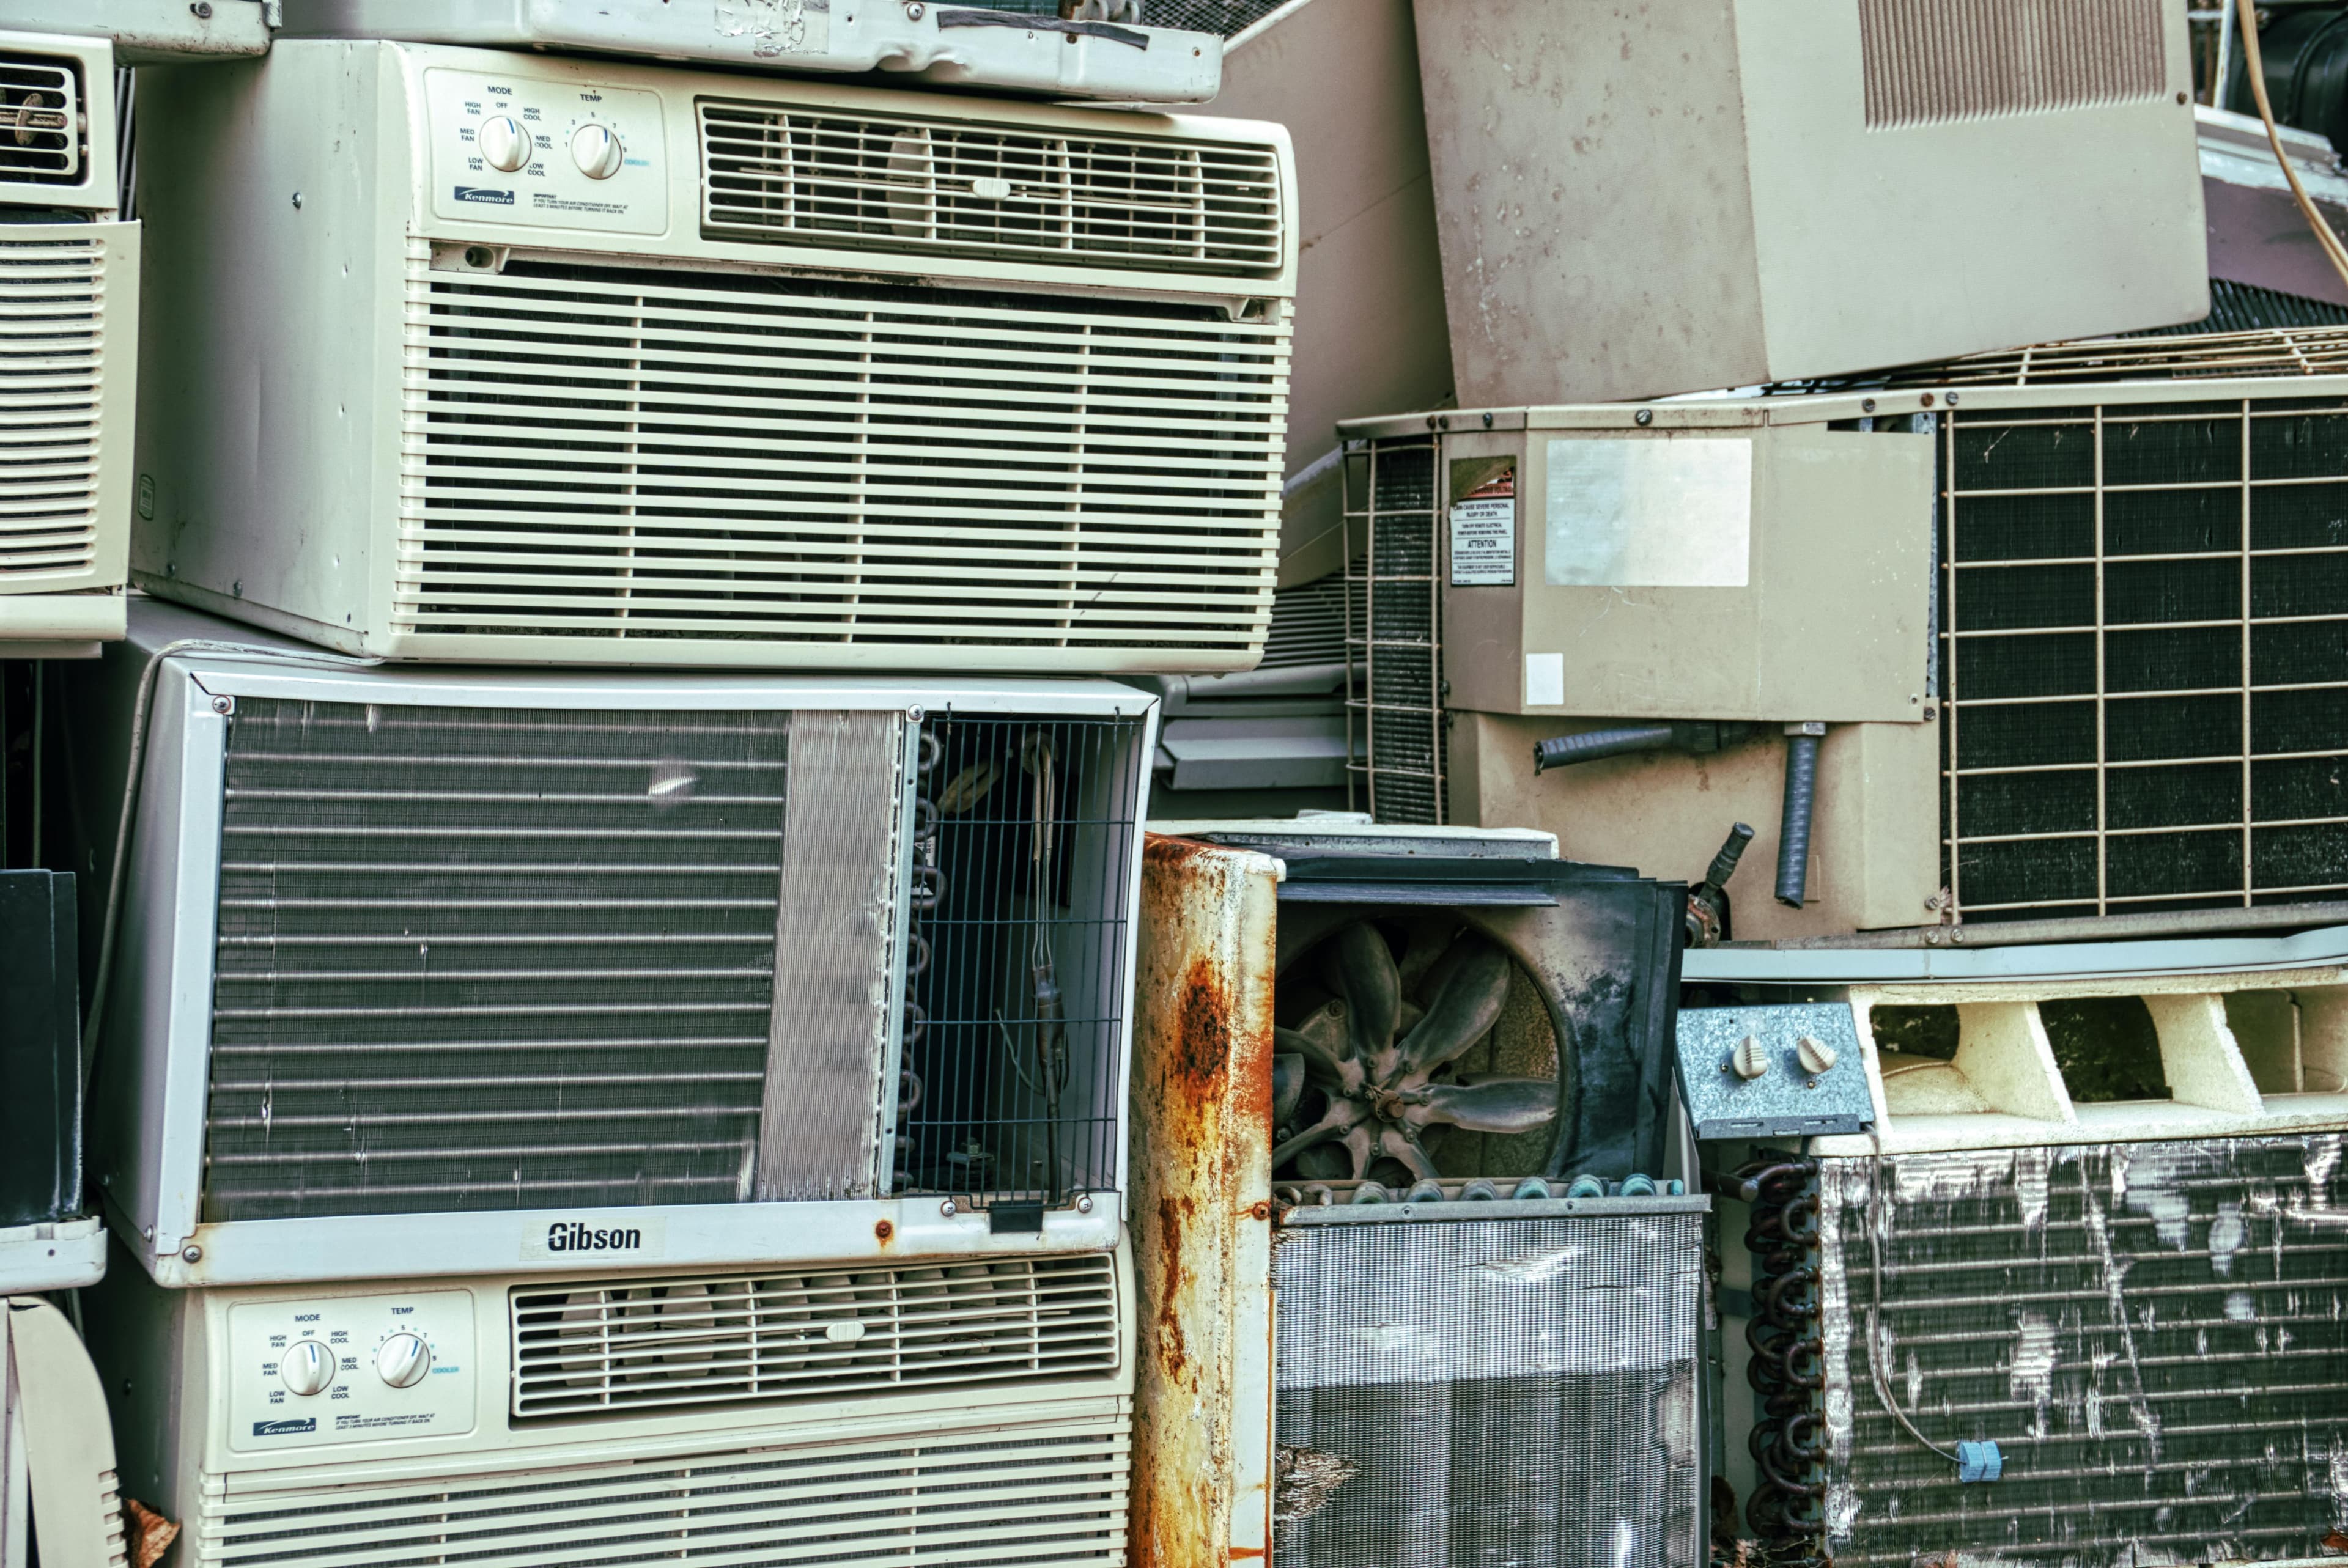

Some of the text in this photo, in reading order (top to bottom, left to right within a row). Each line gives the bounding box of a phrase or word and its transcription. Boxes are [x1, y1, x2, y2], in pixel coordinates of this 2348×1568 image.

[488, 86, 512, 95] MODE
[580, 94, 602, 102] TEMP
[465, 193, 513, 204] Kenmore
[548, 1222, 641, 1251] Gibson
[295, 1314, 320, 1322] MODE
[264, 1424, 315, 1434] Kenmore
